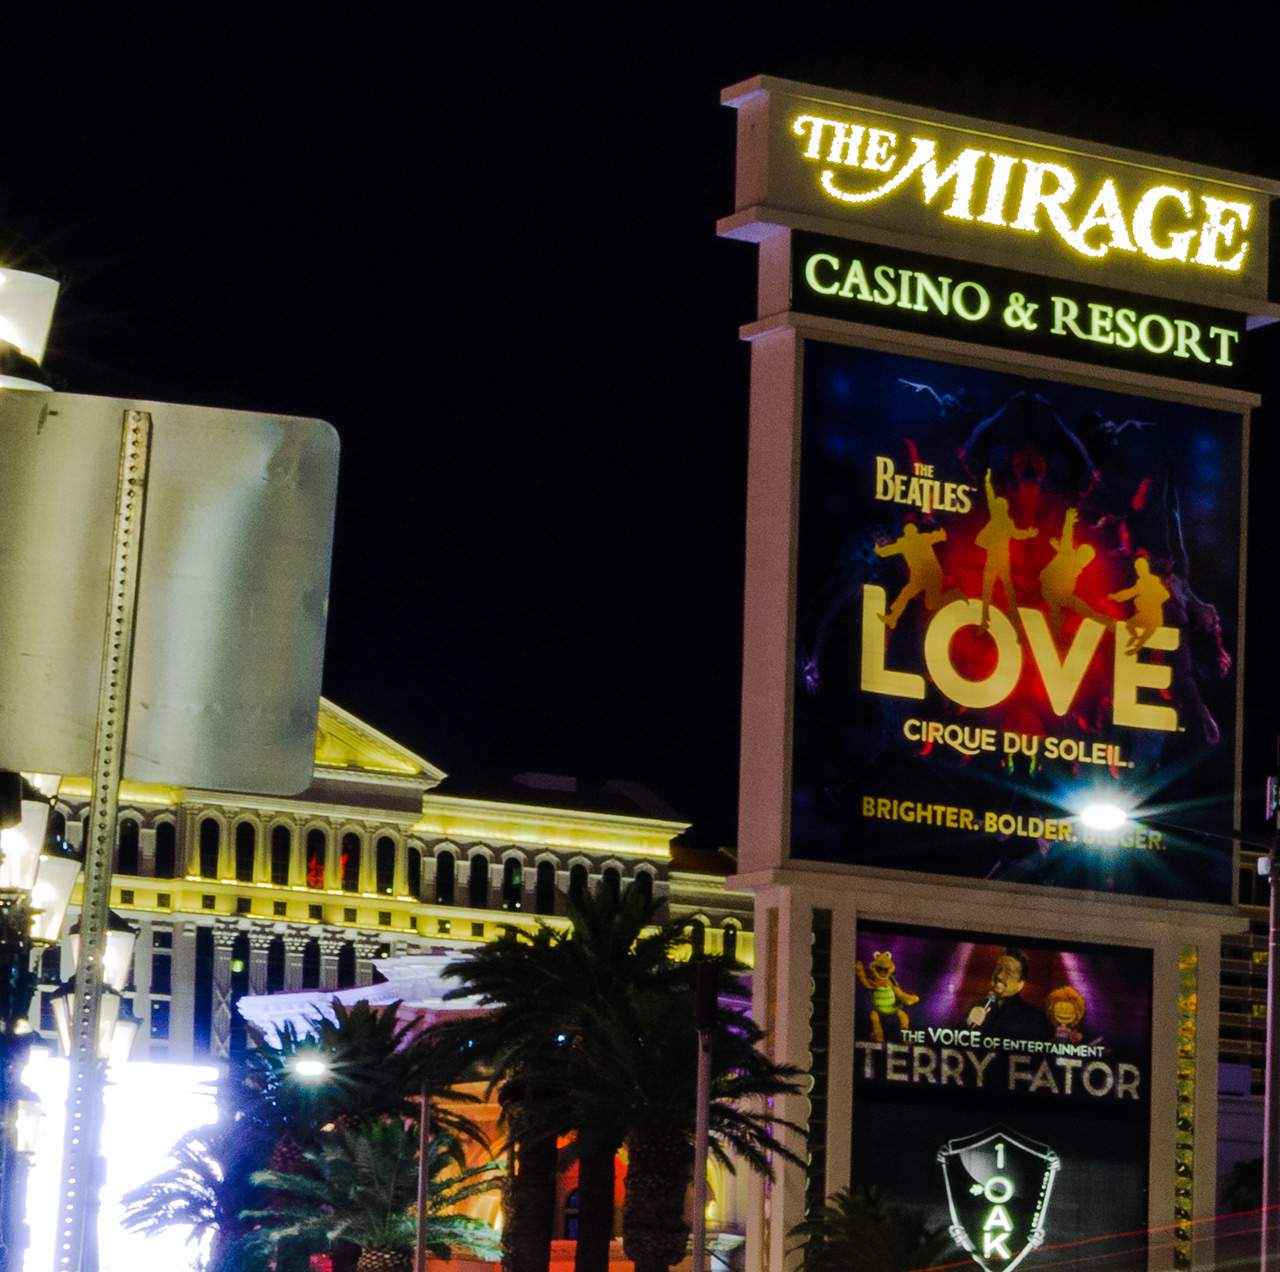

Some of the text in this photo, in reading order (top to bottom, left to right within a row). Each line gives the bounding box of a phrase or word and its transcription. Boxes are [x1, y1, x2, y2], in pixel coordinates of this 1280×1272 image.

[792, 114, 1253, 272] THE MIRAGE
[805, 253, 1240, 367] CASINO & RESORT
[875, 456, 972, 514] BEATLES
[913, 462, 935, 478] THE
[860, 584, 1180, 732] LOVE
[903, 719, 997, 756] CIRQUE
[1003, 731, 1039, 756] DU
[862, 796, 980, 831] BRIGHTER.
[984, 811, 1078, 842] BOLDER.
[855, 1040, 1142, 1100] TERRY FATOR
[901, 1027, 1106, 1058] THE VOICE OF ENTERTAINMENT
